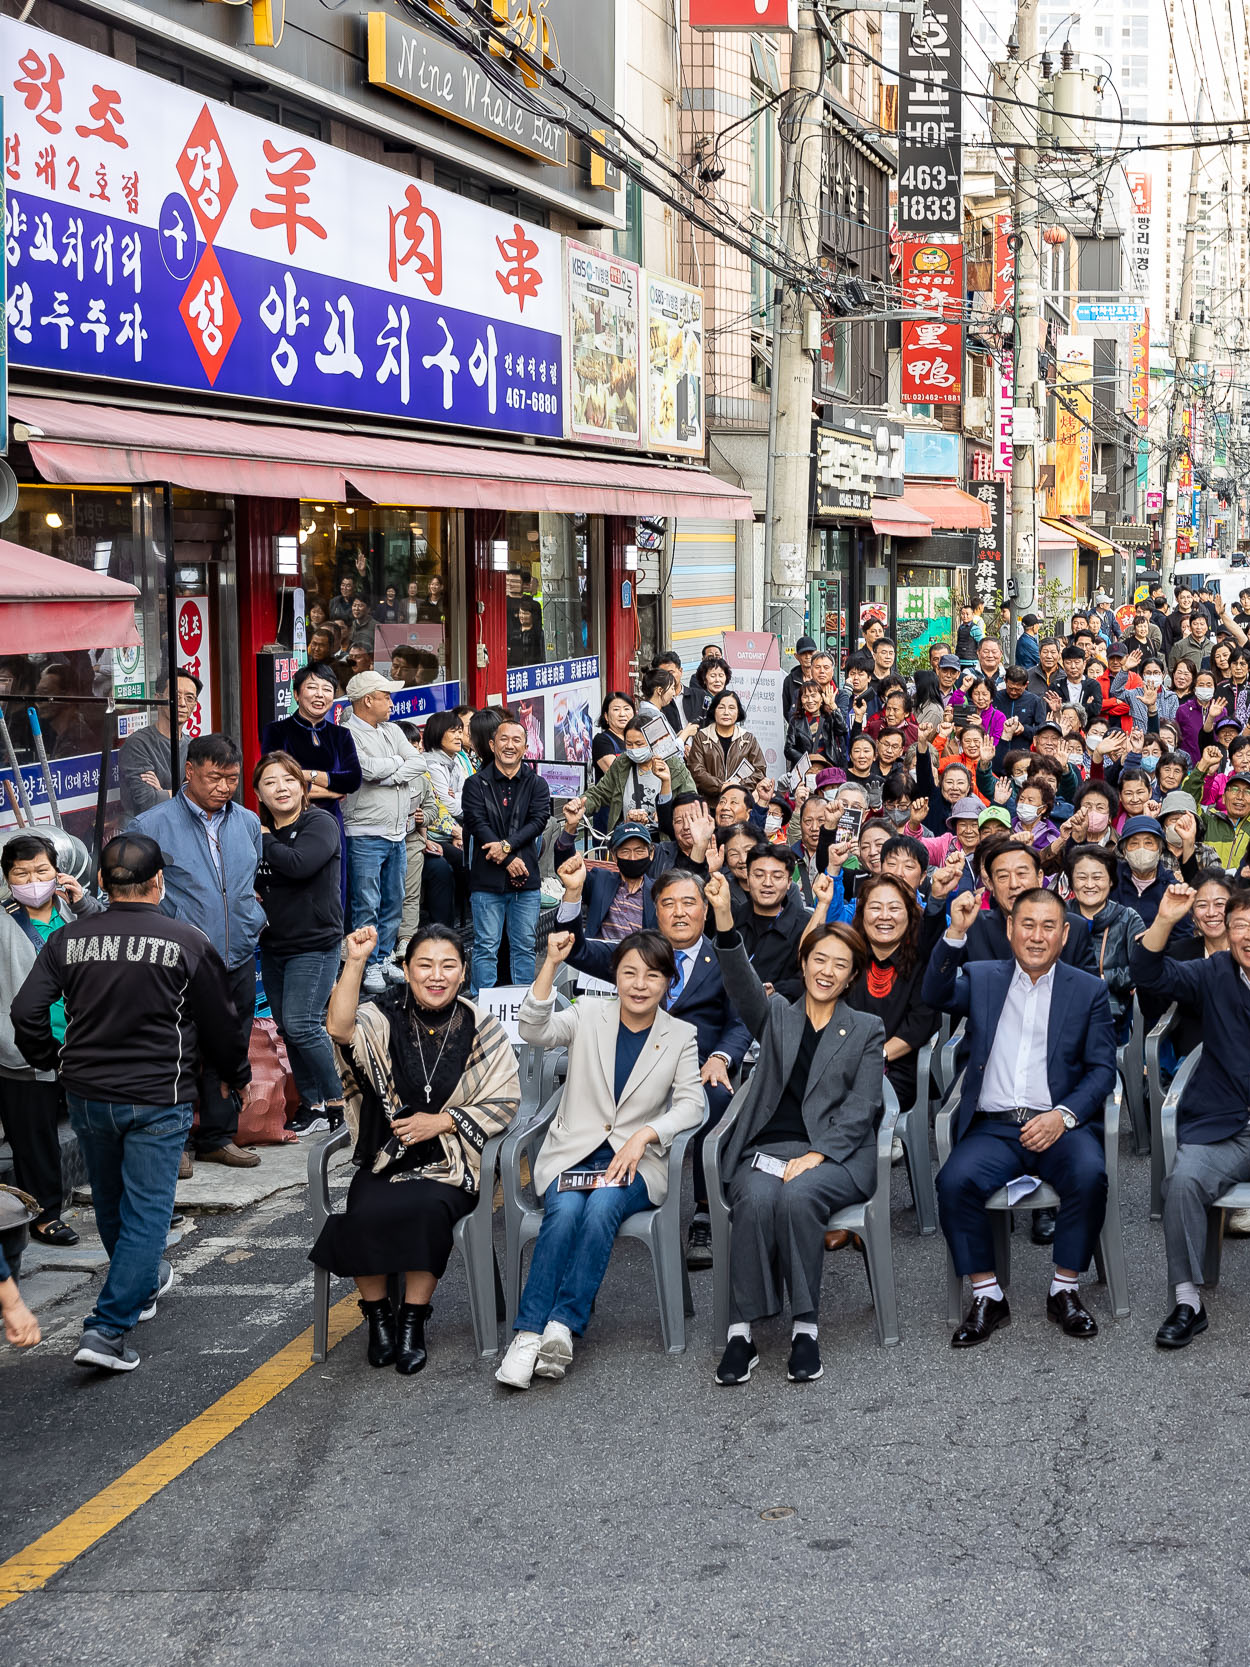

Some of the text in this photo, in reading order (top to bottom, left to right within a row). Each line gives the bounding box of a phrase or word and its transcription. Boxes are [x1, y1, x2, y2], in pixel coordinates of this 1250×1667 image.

[13, 48, 129, 149] 원조
[399, 36, 453, 101] Nine
[533, 115, 562, 162] Bar
[906, 121, 954, 148] HOF
[901, 165, 959, 191] 463-
[901, 195, 956, 221] 1833
[164, 210, 188, 261] 구
[250, 139, 544, 313] 羊肉串
[6, 198, 142, 294] 양꼬치거리
[187, 139, 226, 357] 경성
[572, 256, 587, 278] KBS
[655, 287, 664, 305] SBS
[259, 272, 498, 415] 양꼬치구이
[505, 386, 557, 415] 467-6880
[180, 614, 200, 640] 원조
[66, 935, 181, 968] MAN UTD
